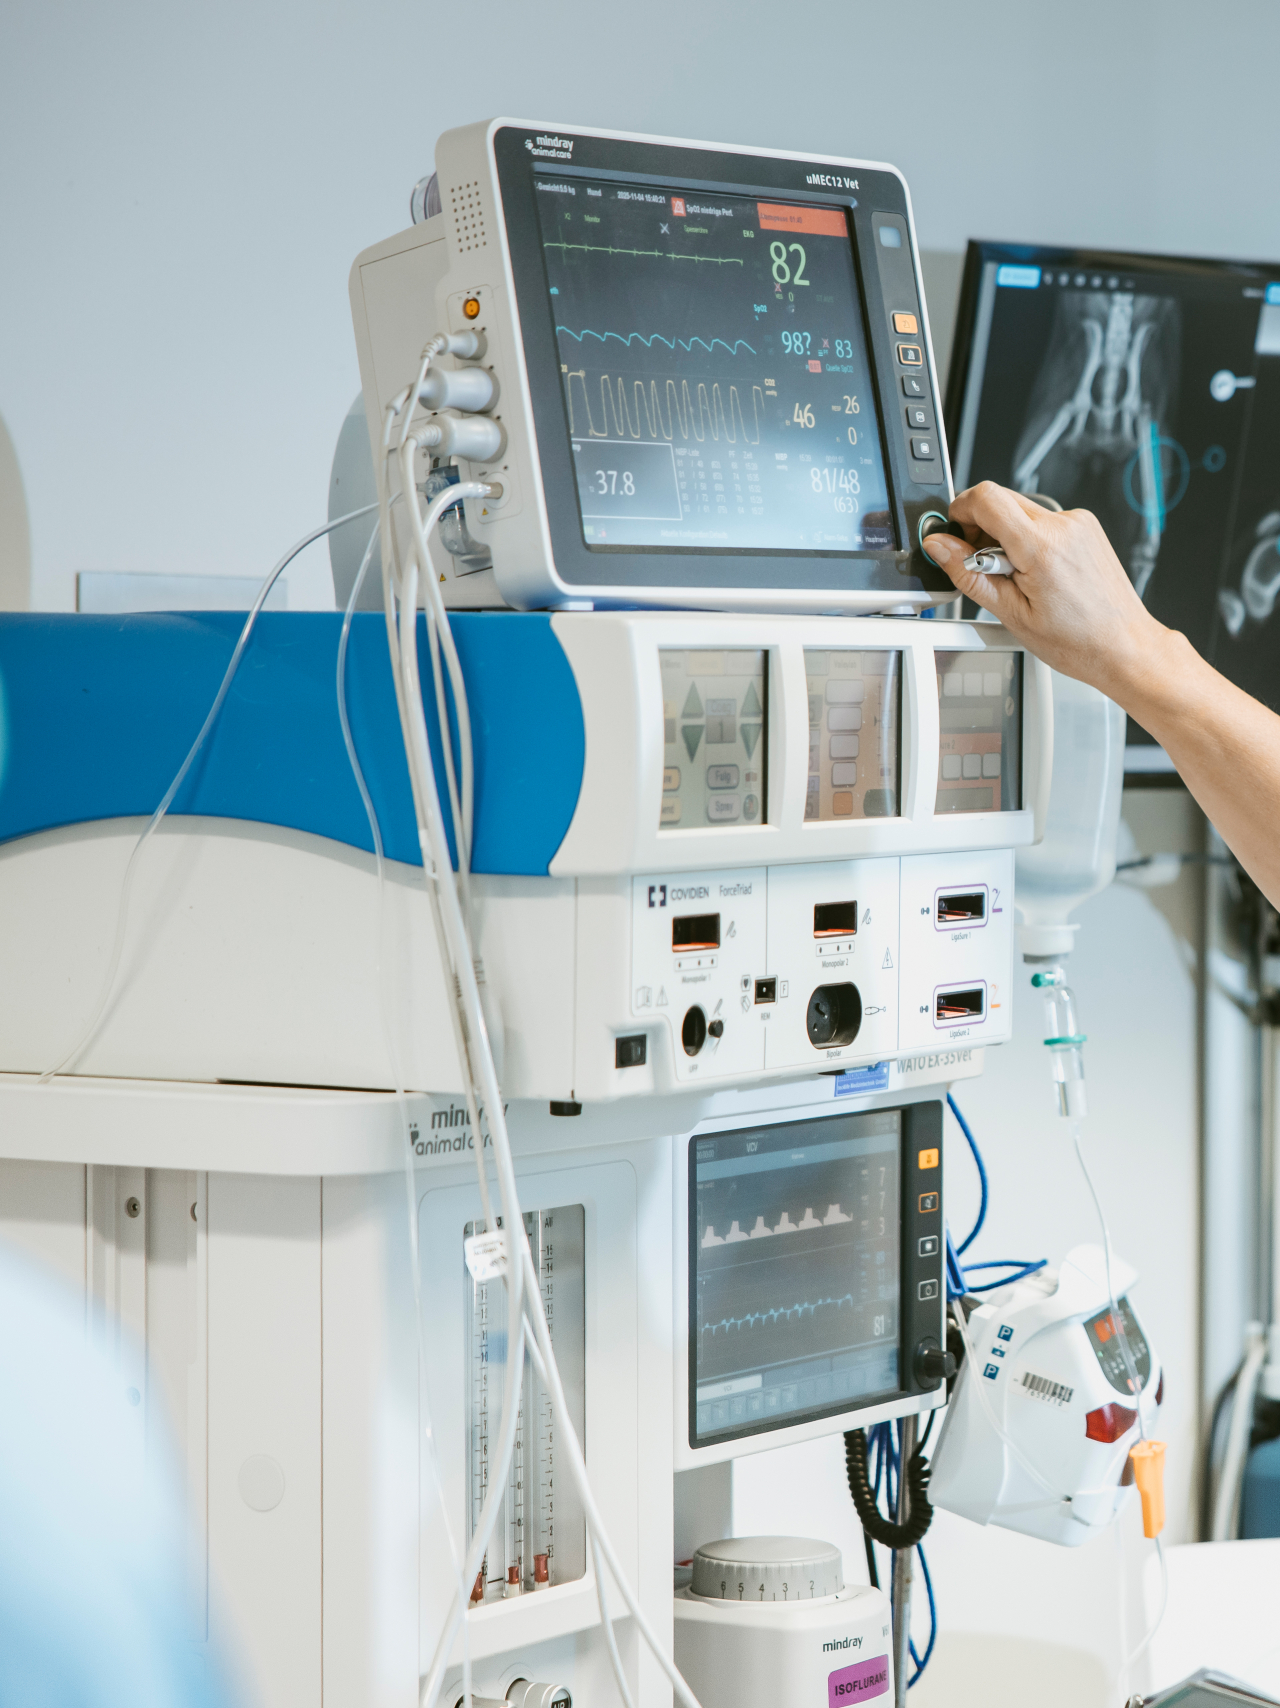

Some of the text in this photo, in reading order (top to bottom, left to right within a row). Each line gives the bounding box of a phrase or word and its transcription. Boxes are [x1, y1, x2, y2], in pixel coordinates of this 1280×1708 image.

[536, 135, 574, 151] mindray
[806, 174, 859, 190] uMEC12 Vet
[586, 187, 602, 197] Hund
[743, 229, 755, 238] EKG
[769, 241, 810, 286] 82
[788, 291, 794, 302] 0
[753, 304, 768, 313] SpO2
[781, 331, 811, 355] 98?
[835, 339, 853, 358] 83
[764, 378, 776, 387] CO2
[843, 395, 860, 415] 26
[793, 402, 816, 429] 46
[848, 427, 857, 446] 0
[595, 470, 635, 496] 37.8
[810, 467, 861, 494] 81/48
[834, 496, 859, 513] (63)
[719, 720, 724, 739] 1
[671, 883, 752, 900] COVIDIEN ForceTriad
[951, 932, 968, 942] LigaSure
[821, 959, 845, 969] Monopolar
[681, 975, 707, 985] Monopolar
[760, 1012, 771, 1021] REM
[950, 1029, 967, 1039] LigaSure
[826, 1050, 842, 1059] Bipolar
[746, 1142, 758, 1153] VCV
[873, 1314, 885, 1337] 81
[720, 1581, 727, 1591] 6
[738, 1583, 745, 1593] 5
[758, 1583, 765, 1593] 4
[782, 1583, 789, 1593] 3
[809, 1580, 815, 1590] 2
[822, 1636, 863, 1652] mindray
[835, 1670, 887, 1696] ISOFLURANE
